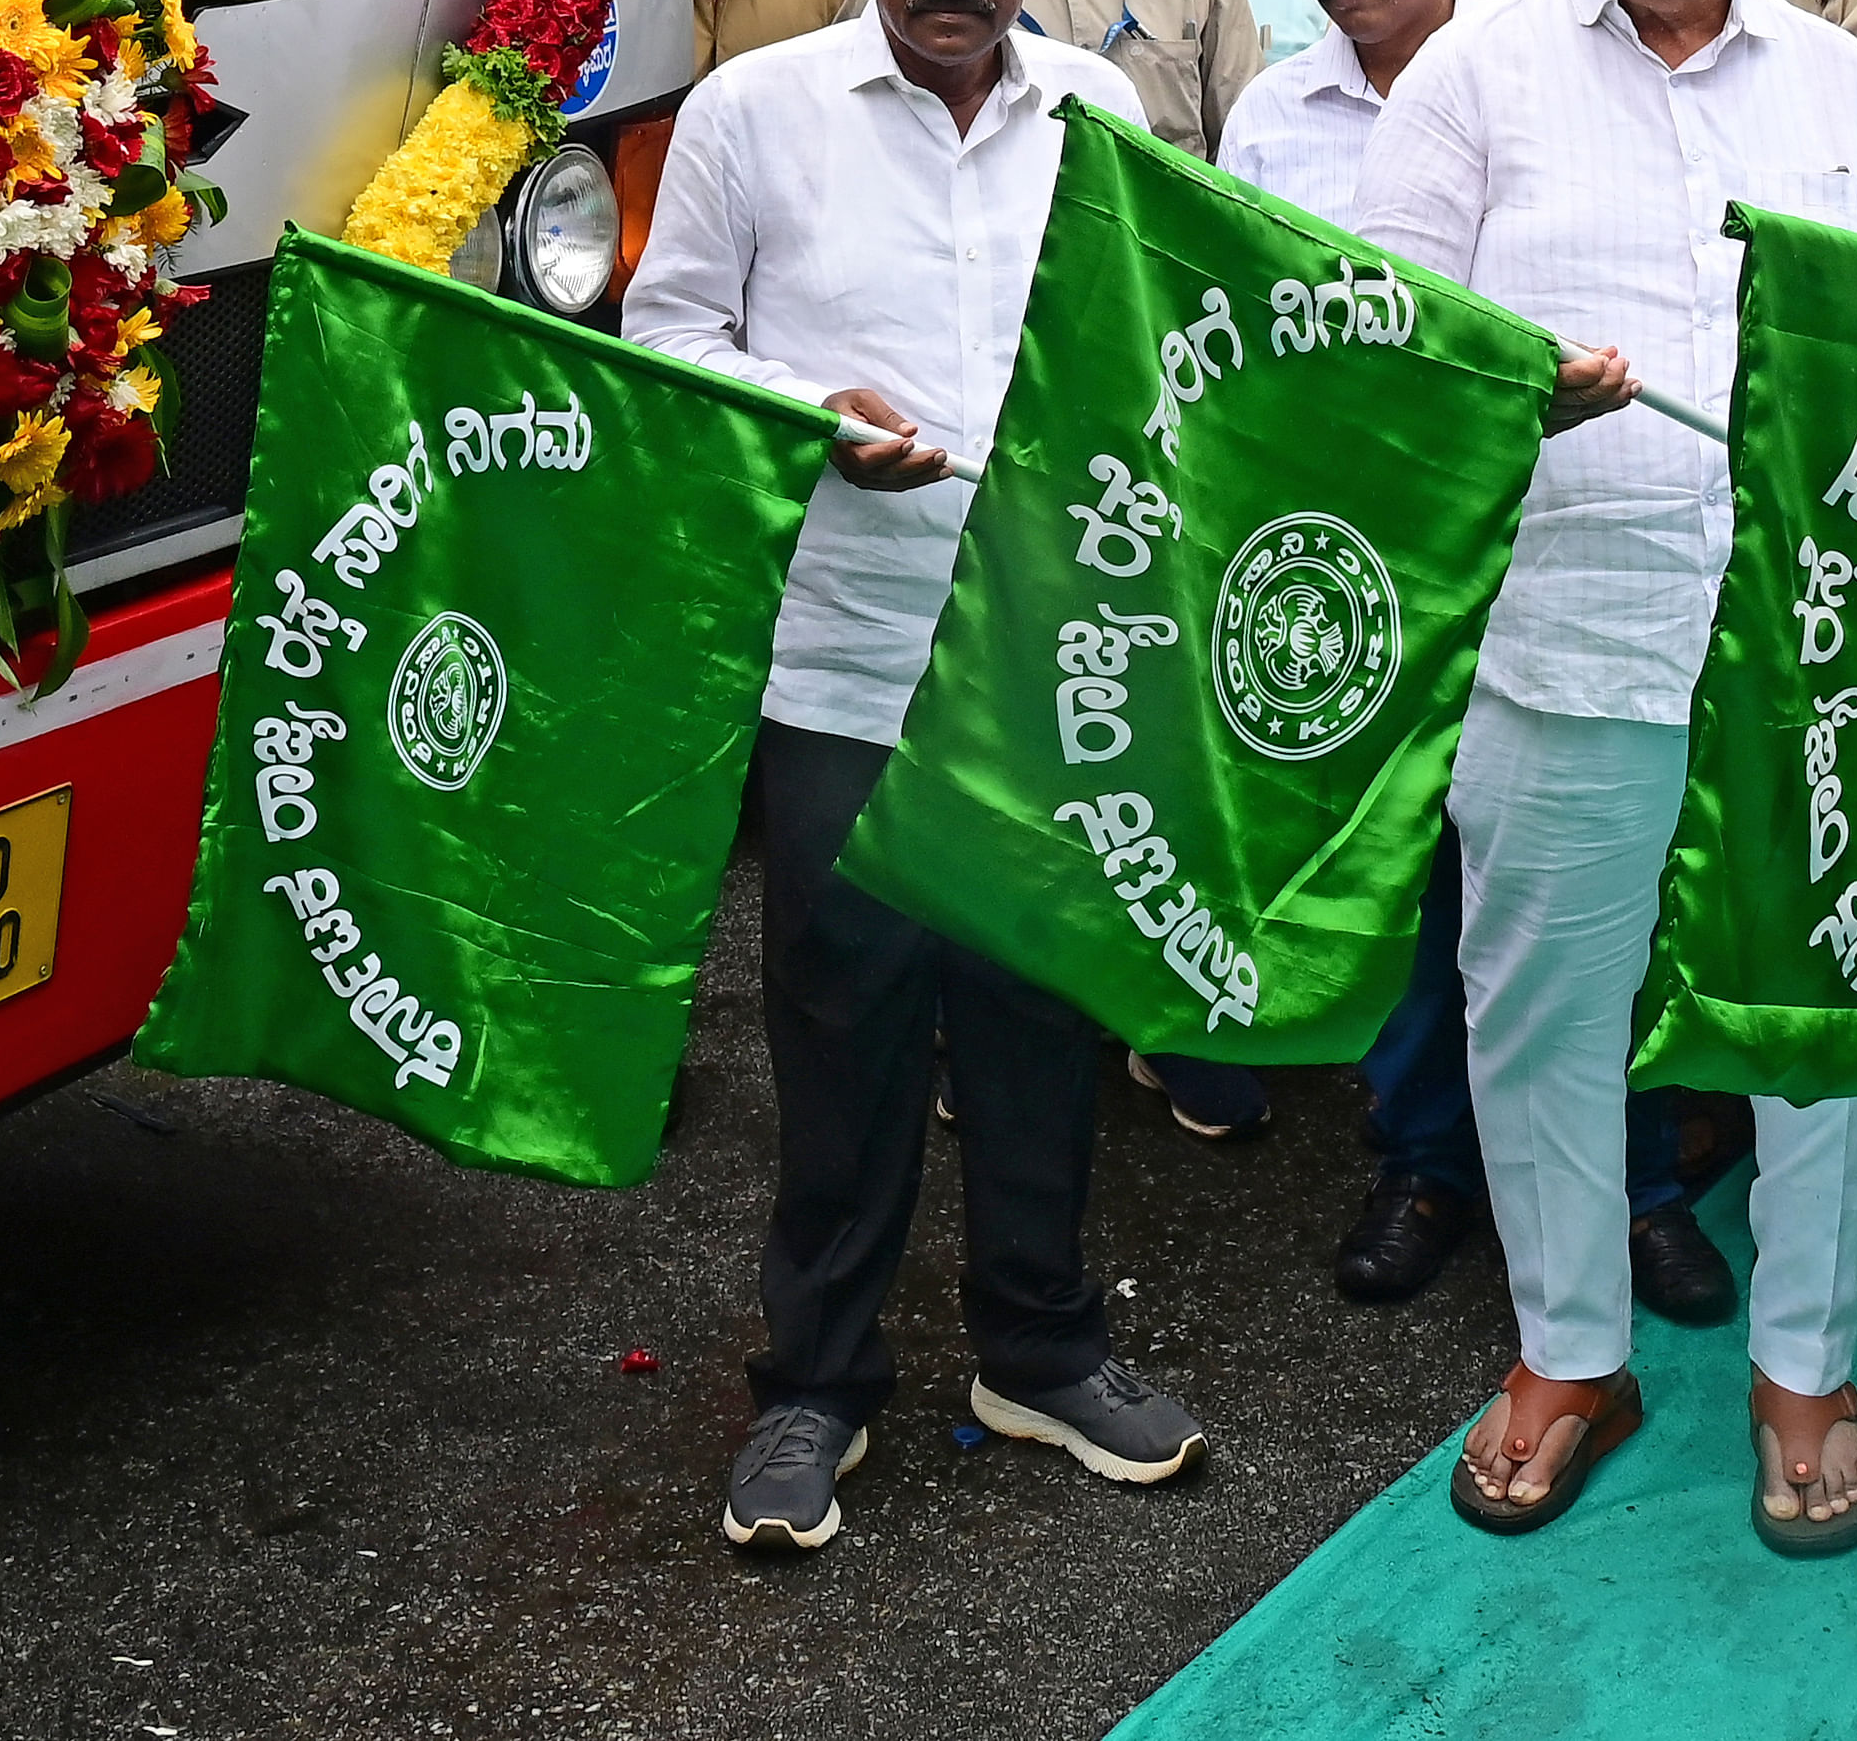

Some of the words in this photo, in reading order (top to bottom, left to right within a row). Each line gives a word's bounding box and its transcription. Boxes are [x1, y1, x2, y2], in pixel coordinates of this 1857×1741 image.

[1268, 255, 1418, 358] ನಿಗಮ
[311, 419, 438, 592] ಸಾರಿಗೆ
[443, 389, 596, 479] ನಿಗಮ
[1066, 452, 1183, 581] ರಸ್ತೆ
[255, 566, 368, 681] ರಸ್ತೆ
[1054, 601, 1179, 766] ರಾಜ್ಯ
[252, 699, 348, 843] ರಾಜ್ಯ
[263, 866, 465, 1090] ಕರ್ನಾಟಕ
[1053, 789, 1260, 1035] ಕರ್ನಾಟಕ
